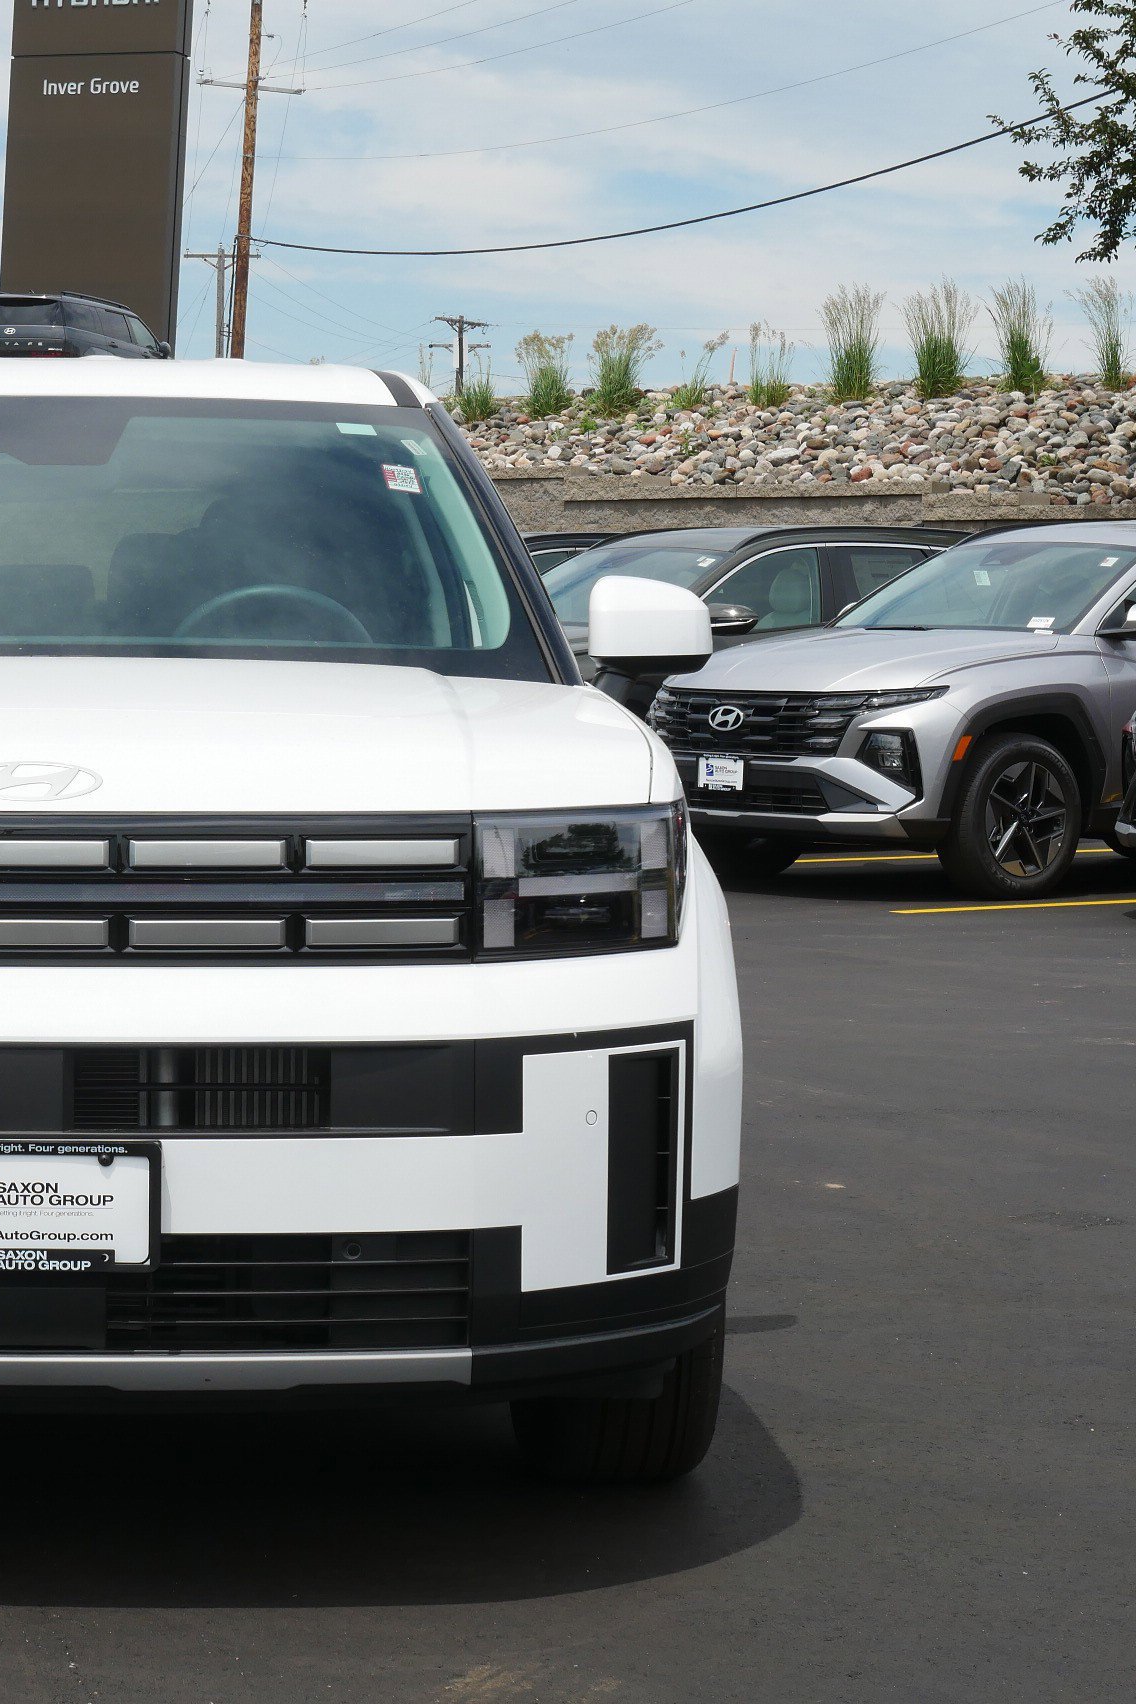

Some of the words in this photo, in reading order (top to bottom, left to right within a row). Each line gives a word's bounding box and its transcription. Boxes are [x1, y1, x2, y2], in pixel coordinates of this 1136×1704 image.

[43, 79, 84, 95] Inver
[90, 78, 139, 94] Grove
[28, 1144, 54, 1152] Four
[57, 1144, 128, 1154] generations.
[48, 1195, 114, 1206] GROUP
[38, 1260, 92, 1270] GROUP
